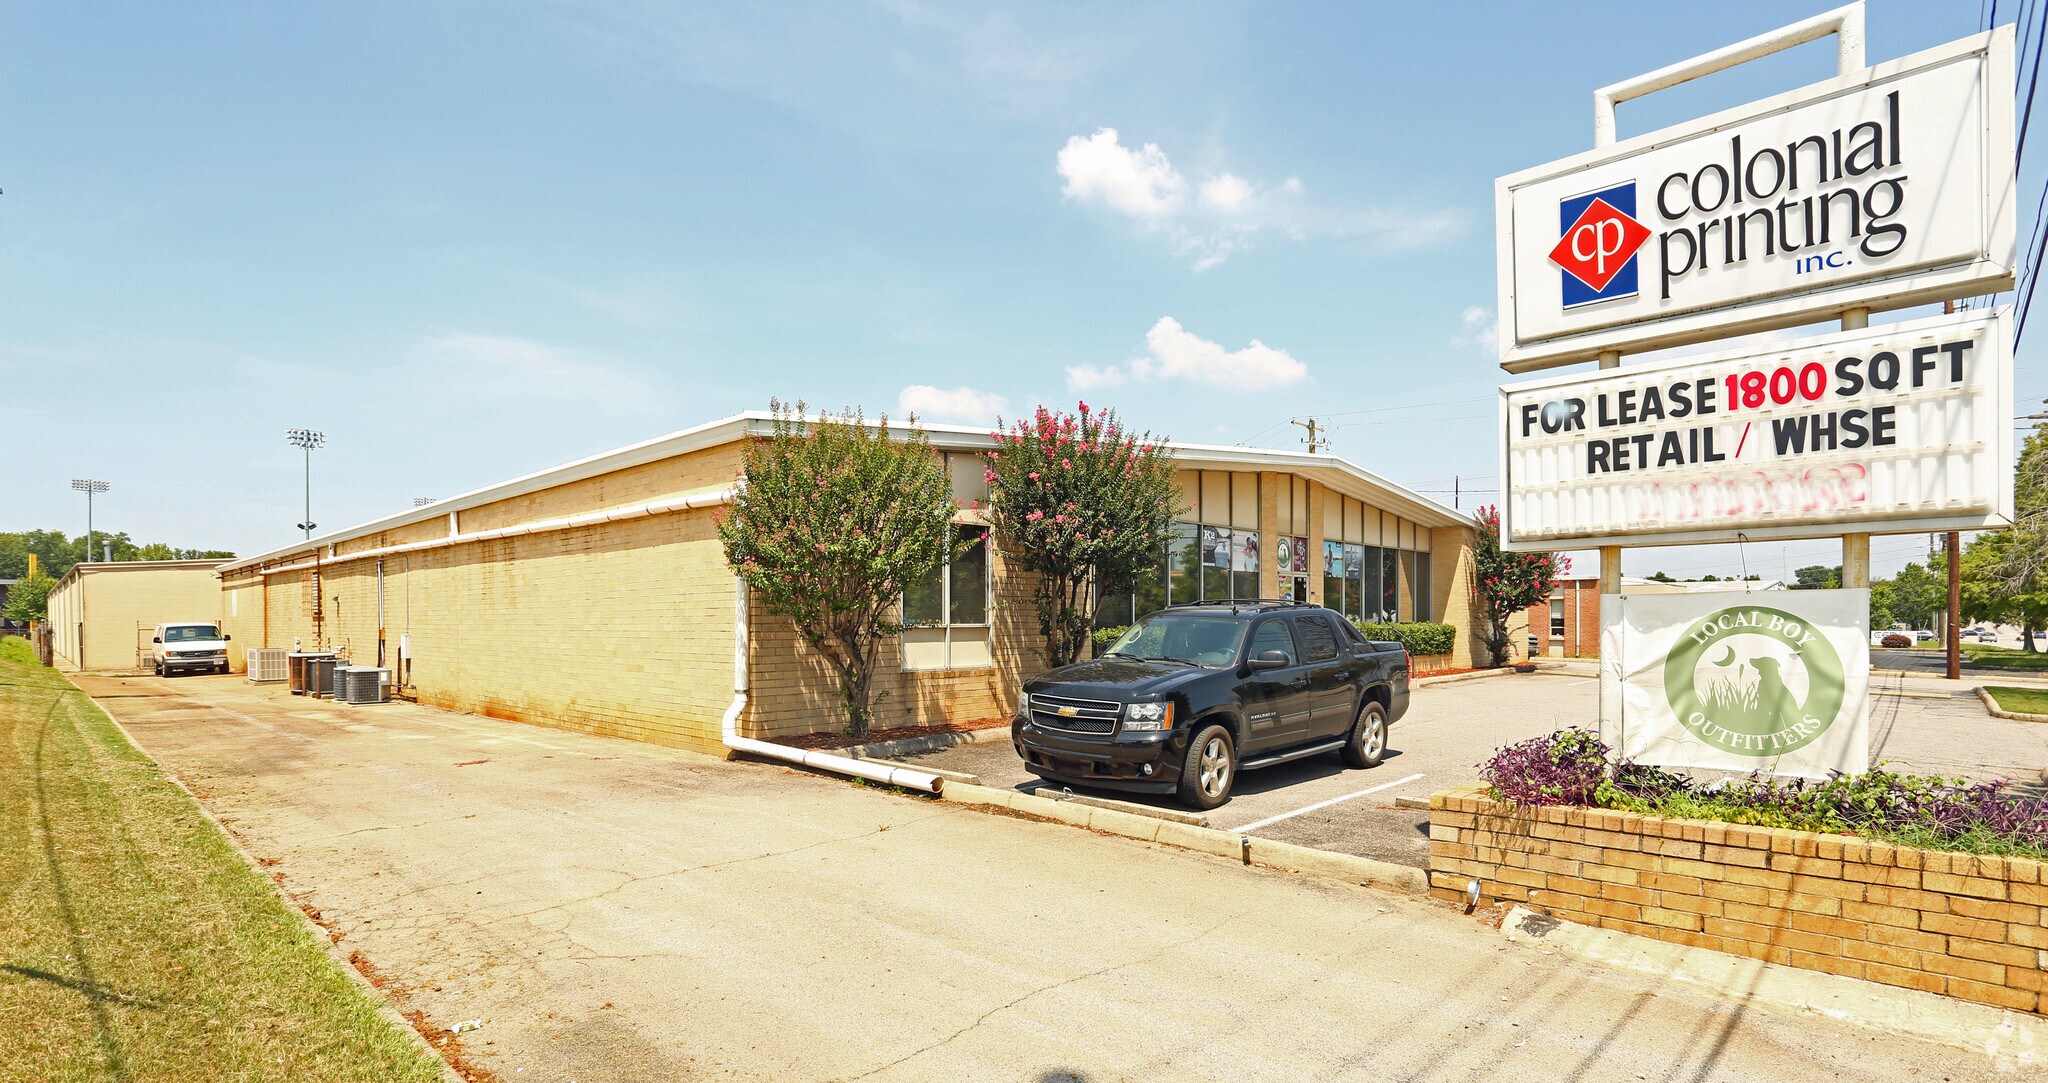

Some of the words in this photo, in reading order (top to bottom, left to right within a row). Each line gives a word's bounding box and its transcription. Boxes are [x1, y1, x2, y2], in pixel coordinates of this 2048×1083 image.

[1657, 90, 1902, 220] colonial
[1571, 217, 1625, 275] cp
[1659, 175, 1908, 299] printing
[1796, 250, 1853, 275] inc.
[1522, 397, 1586, 437] FOR
[1598, 377, 1716, 428] LEASE
[1725, 361, 1827, 411] 1800
[1834, 351, 1901, 397] SQ
[1912, 339, 1974, 388] FT
[1587, 426, 1726, 474] RETAIL
[1772, 405, 1896, 456] WHSE
[1203, 530, 1216, 541] K2
[1689, 611, 1764, 646] LOCAL
[1766, 614, 1817, 648] BOY
[1688, 711, 1822, 751] OUTFITTERS
